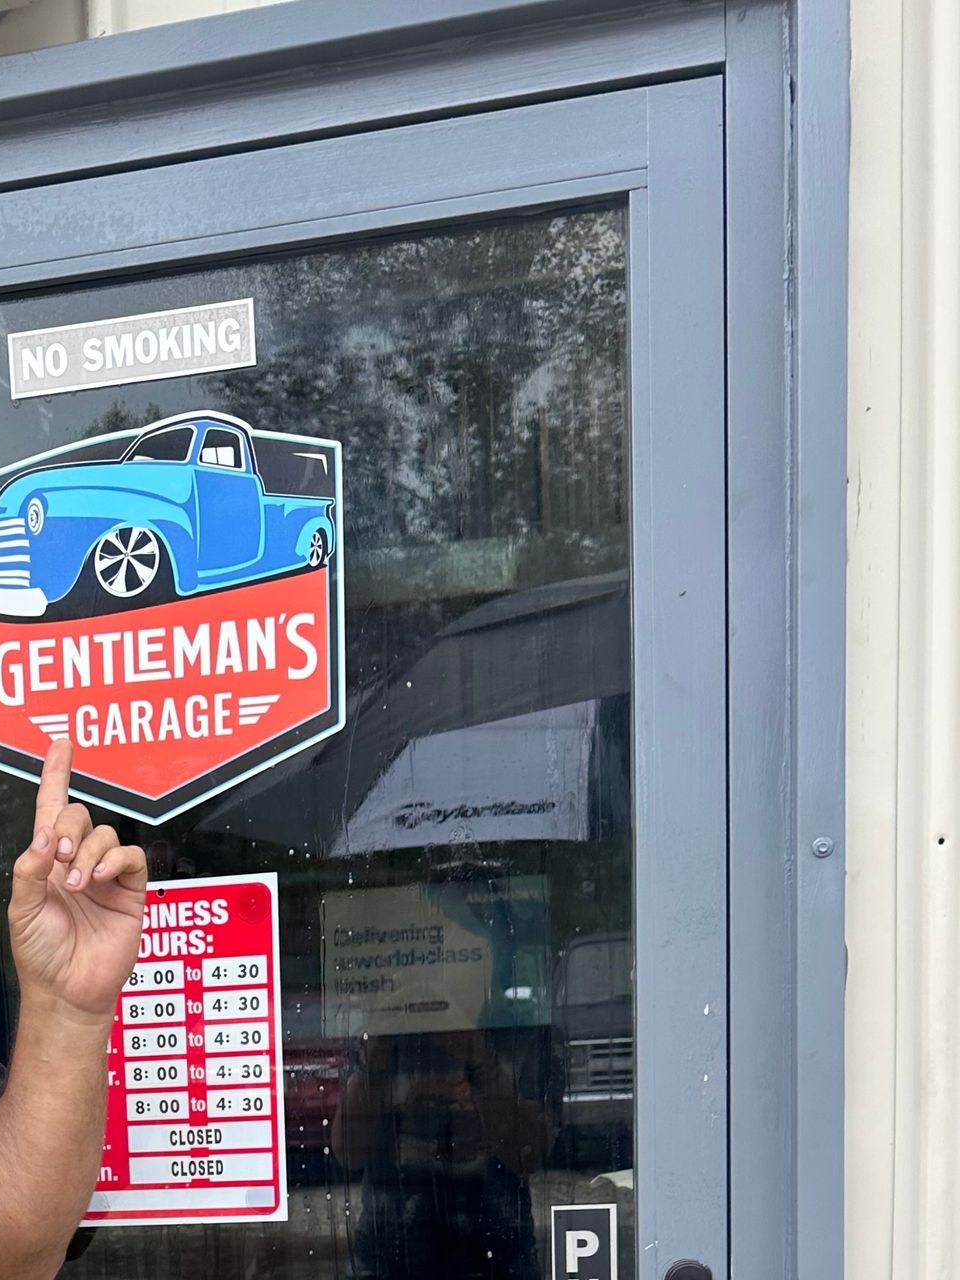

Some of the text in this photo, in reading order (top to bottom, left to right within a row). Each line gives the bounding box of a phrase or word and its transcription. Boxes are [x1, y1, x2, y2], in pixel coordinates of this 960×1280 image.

[20, 317, 241, 382] NO SMOKING
[74, 691, 234, 748] GARAGE
[138, 929, 214, 958] OURS:
[185, 966, 202, 981] to
[187, 999, 203, 1014] to
[188, 1032, 204, 1047] to
[189, 1065, 205, 1080] to
[190, 1096, 206, 1112] to
[169, 1128, 223, 1146] CLOSED
[171, 1159, 224, 1177] CLOSED
